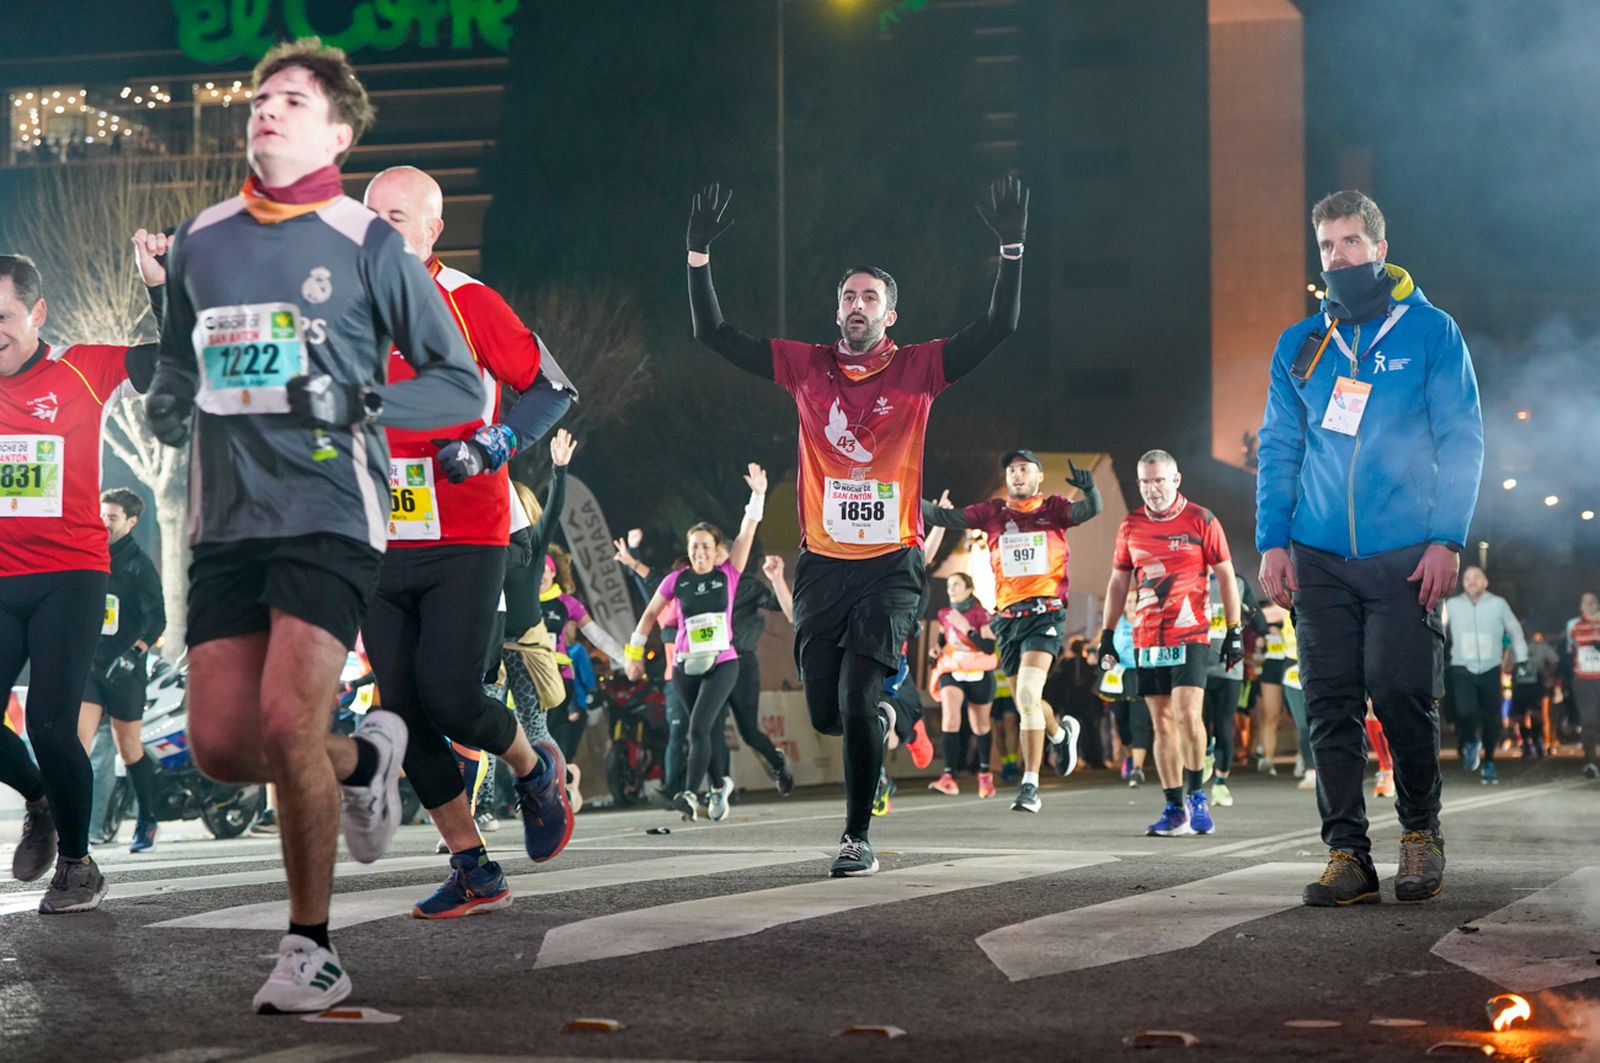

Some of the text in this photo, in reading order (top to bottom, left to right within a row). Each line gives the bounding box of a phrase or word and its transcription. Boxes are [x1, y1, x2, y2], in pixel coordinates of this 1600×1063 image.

[221, 343, 280, 377] 1222
[836, 435, 856, 453] 43
[1, 464, 41, 489] 831
[832, 491, 847, 500] SAN
[841, 484, 862, 492] NOCHE
[864, 483, 871, 492] DE
[838, 501, 885, 521] 1858
[581, 499, 630, 615] JAPEMASA
[1013, 547, 1035, 562] 997
[700, 627, 715, 639] 35
